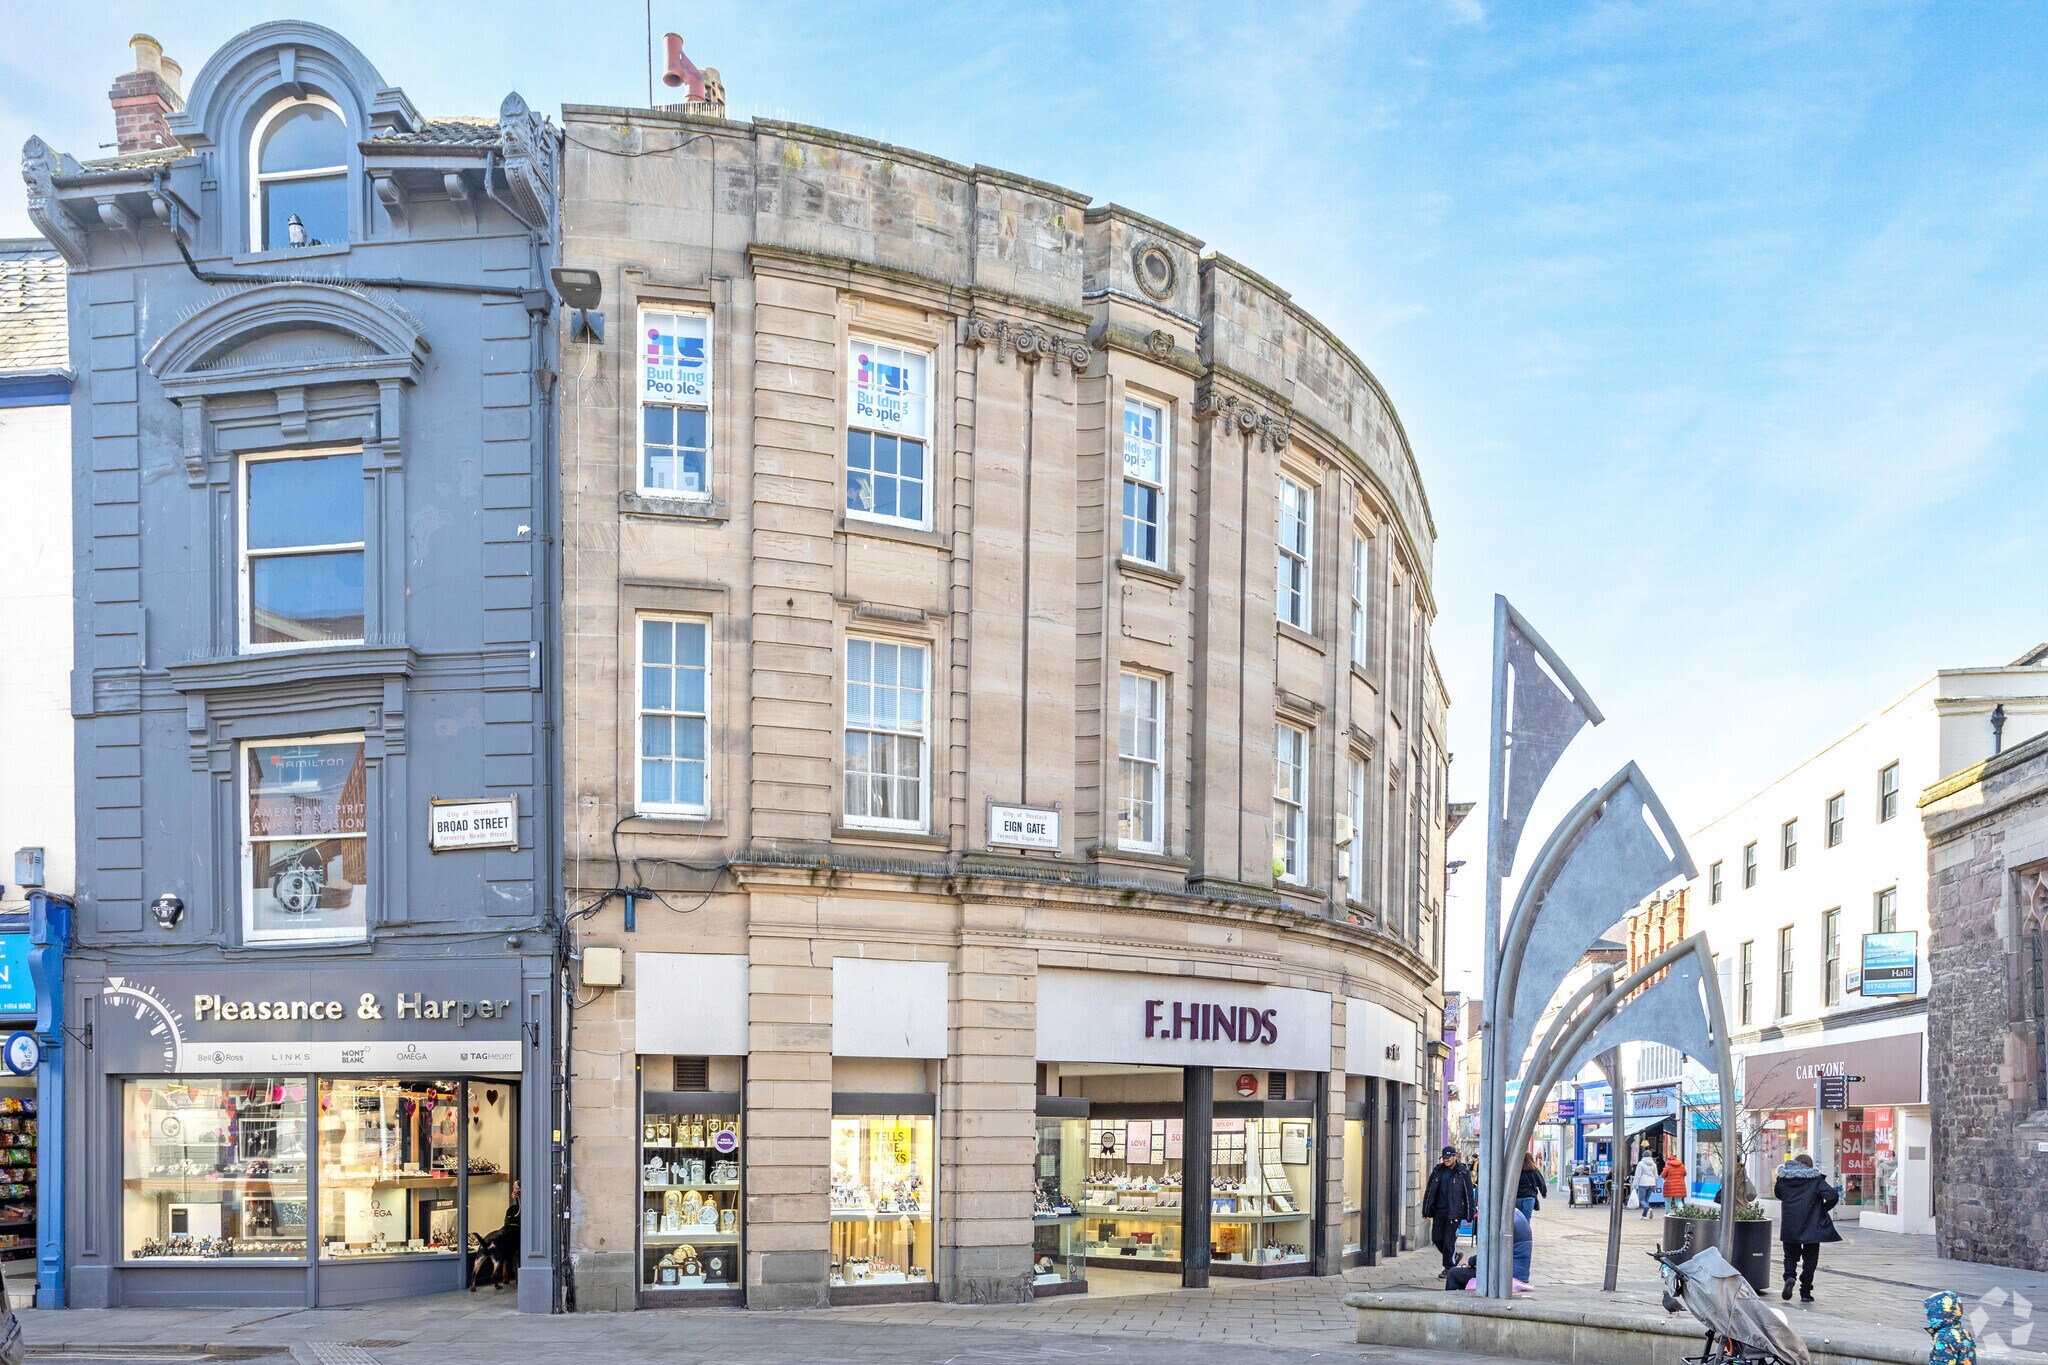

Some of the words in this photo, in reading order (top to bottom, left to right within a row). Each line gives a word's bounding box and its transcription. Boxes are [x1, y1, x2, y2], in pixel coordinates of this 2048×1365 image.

[647, 367, 705, 386] Building
[857, 390, 909, 415] Bulding
[1124, 454, 1146, 467] ople
[276, 758, 344, 769] HAMILTON
[253, 805, 322, 818] AMERICAN
[328, 803, 365, 815] SPIRIT
[473, 808, 499, 816] Hereford
[1025, 812, 1048, 820] Hereford
[253, 821, 290, 832] SWISS
[296, 818, 365, 831] PRECISION
[437, 819, 469, 833] BROAD
[473, 816, 509, 830] STREET
[1004, 821, 1022, 832] EIGN
[1027, 823, 1045, 834] GATE
[1891, 968, 1913, 978] Halls
[18, 1002, 32, 1010] 9AB
[194, 994, 344, 1021] Pleasance
[357, 992, 382, 1020] &
[397, 992, 510, 1027] Harper
[1145, 999, 1278, 1045] F.HINDS
[197, 1054, 212, 1062] Bell
[226, 1054, 244, 1062] Ross
[271, 1053, 311, 1061] LINKS
[341, 1056, 365, 1064] BLANC
[396, 1053, 428, 1061] OMEGA
[1795, 1061, 1845, 1080] CARDZONE
[1878, 1113, 1889, 1121] SALE
[875, 1131, 904, 1142] TELLS
[1171, 1133, 1183, 1142] 50
[1875, 1127, 1892, 1144] SALE
[1130, 1139, 1147, 1147] LOVE
[1878, 1151, 1889, 1160] SALE
[358, 1209, 393, 1218] OMEGA
